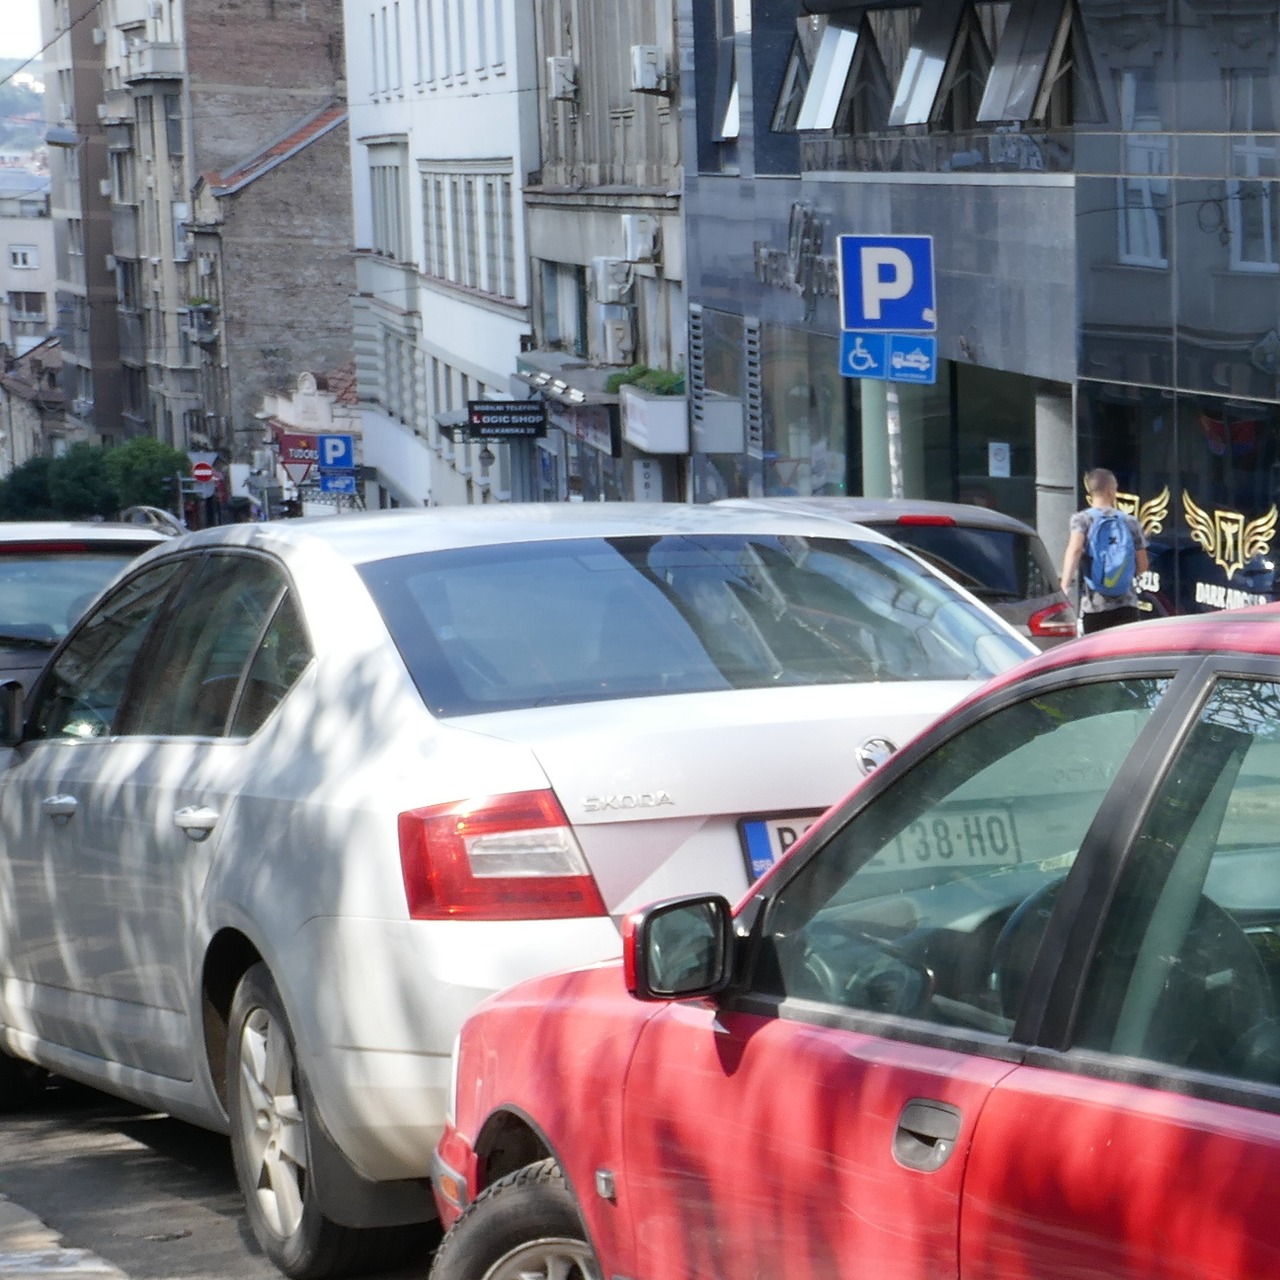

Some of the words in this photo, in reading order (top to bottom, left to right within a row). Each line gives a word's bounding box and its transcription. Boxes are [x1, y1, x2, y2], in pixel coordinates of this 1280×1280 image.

[861, 247, 914, 320] P
[472, 414, 510, 424] LOGIC
[511, 415, 544, 424] SHOP
[325, 438, 346, 465] P
[1196, 583, 1226, 610] DARK
